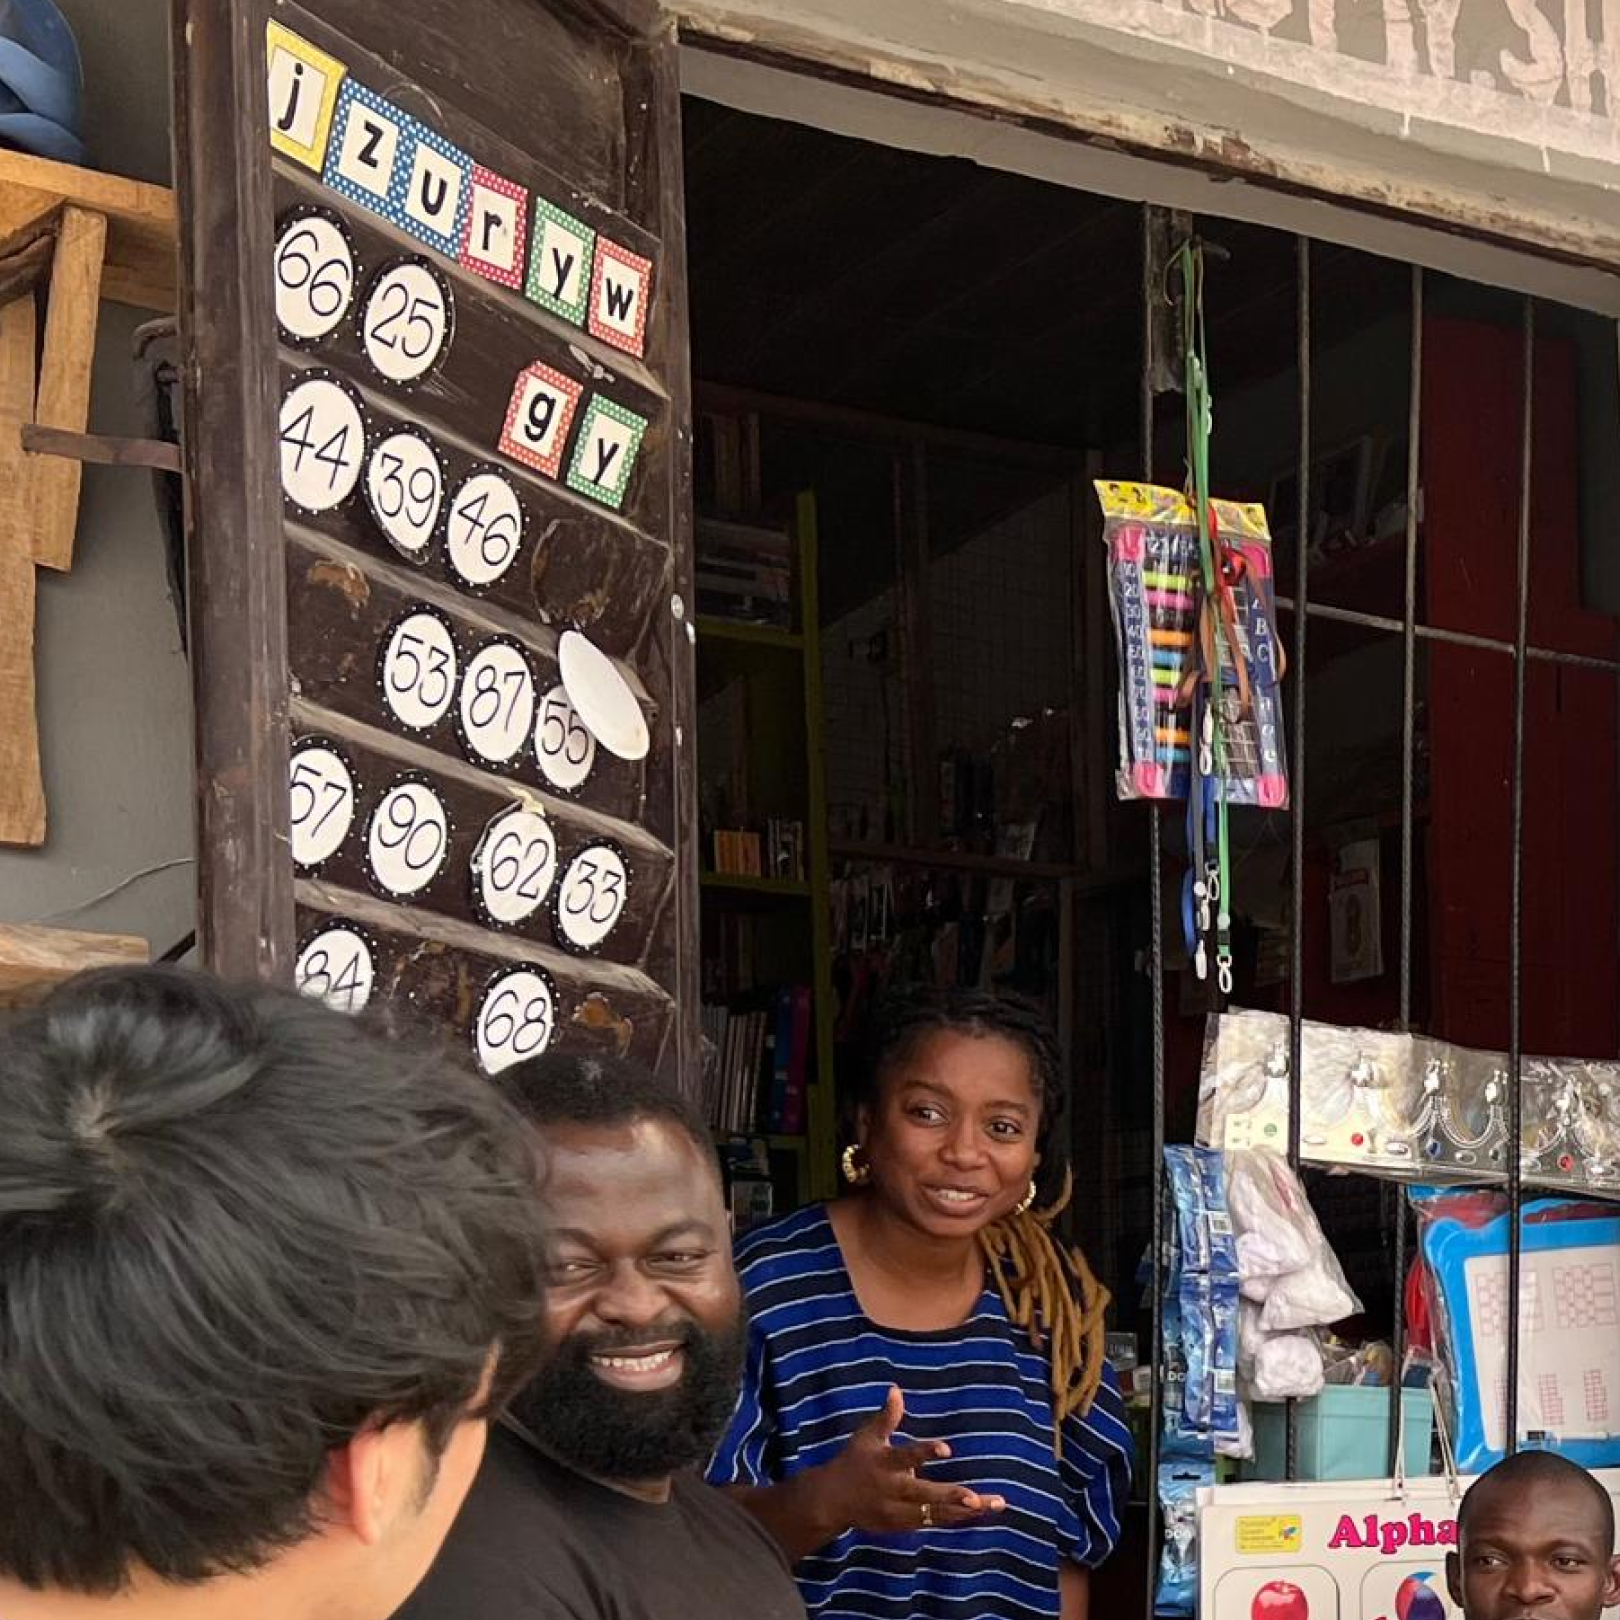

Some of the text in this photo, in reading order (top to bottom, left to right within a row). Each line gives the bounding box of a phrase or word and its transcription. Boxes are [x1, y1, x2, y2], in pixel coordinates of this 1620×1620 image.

[278, 63, 633, 320] j z u r y w
[278, 230, 438, 358] 66 25
[282, 405, 516, 566] 44 39 46
[525, 393, 618, 485] g y
[1255, 618, 1267, 635] B
[1257, 644, 1269, 662] C
[392, 634, 589, 764] 53 87 55
[291, 764, 621, 923] 57 90 62 33
[302, 951, 545, 1053] 84 68
[1327, 1513, 1457, 1555] Alpha
